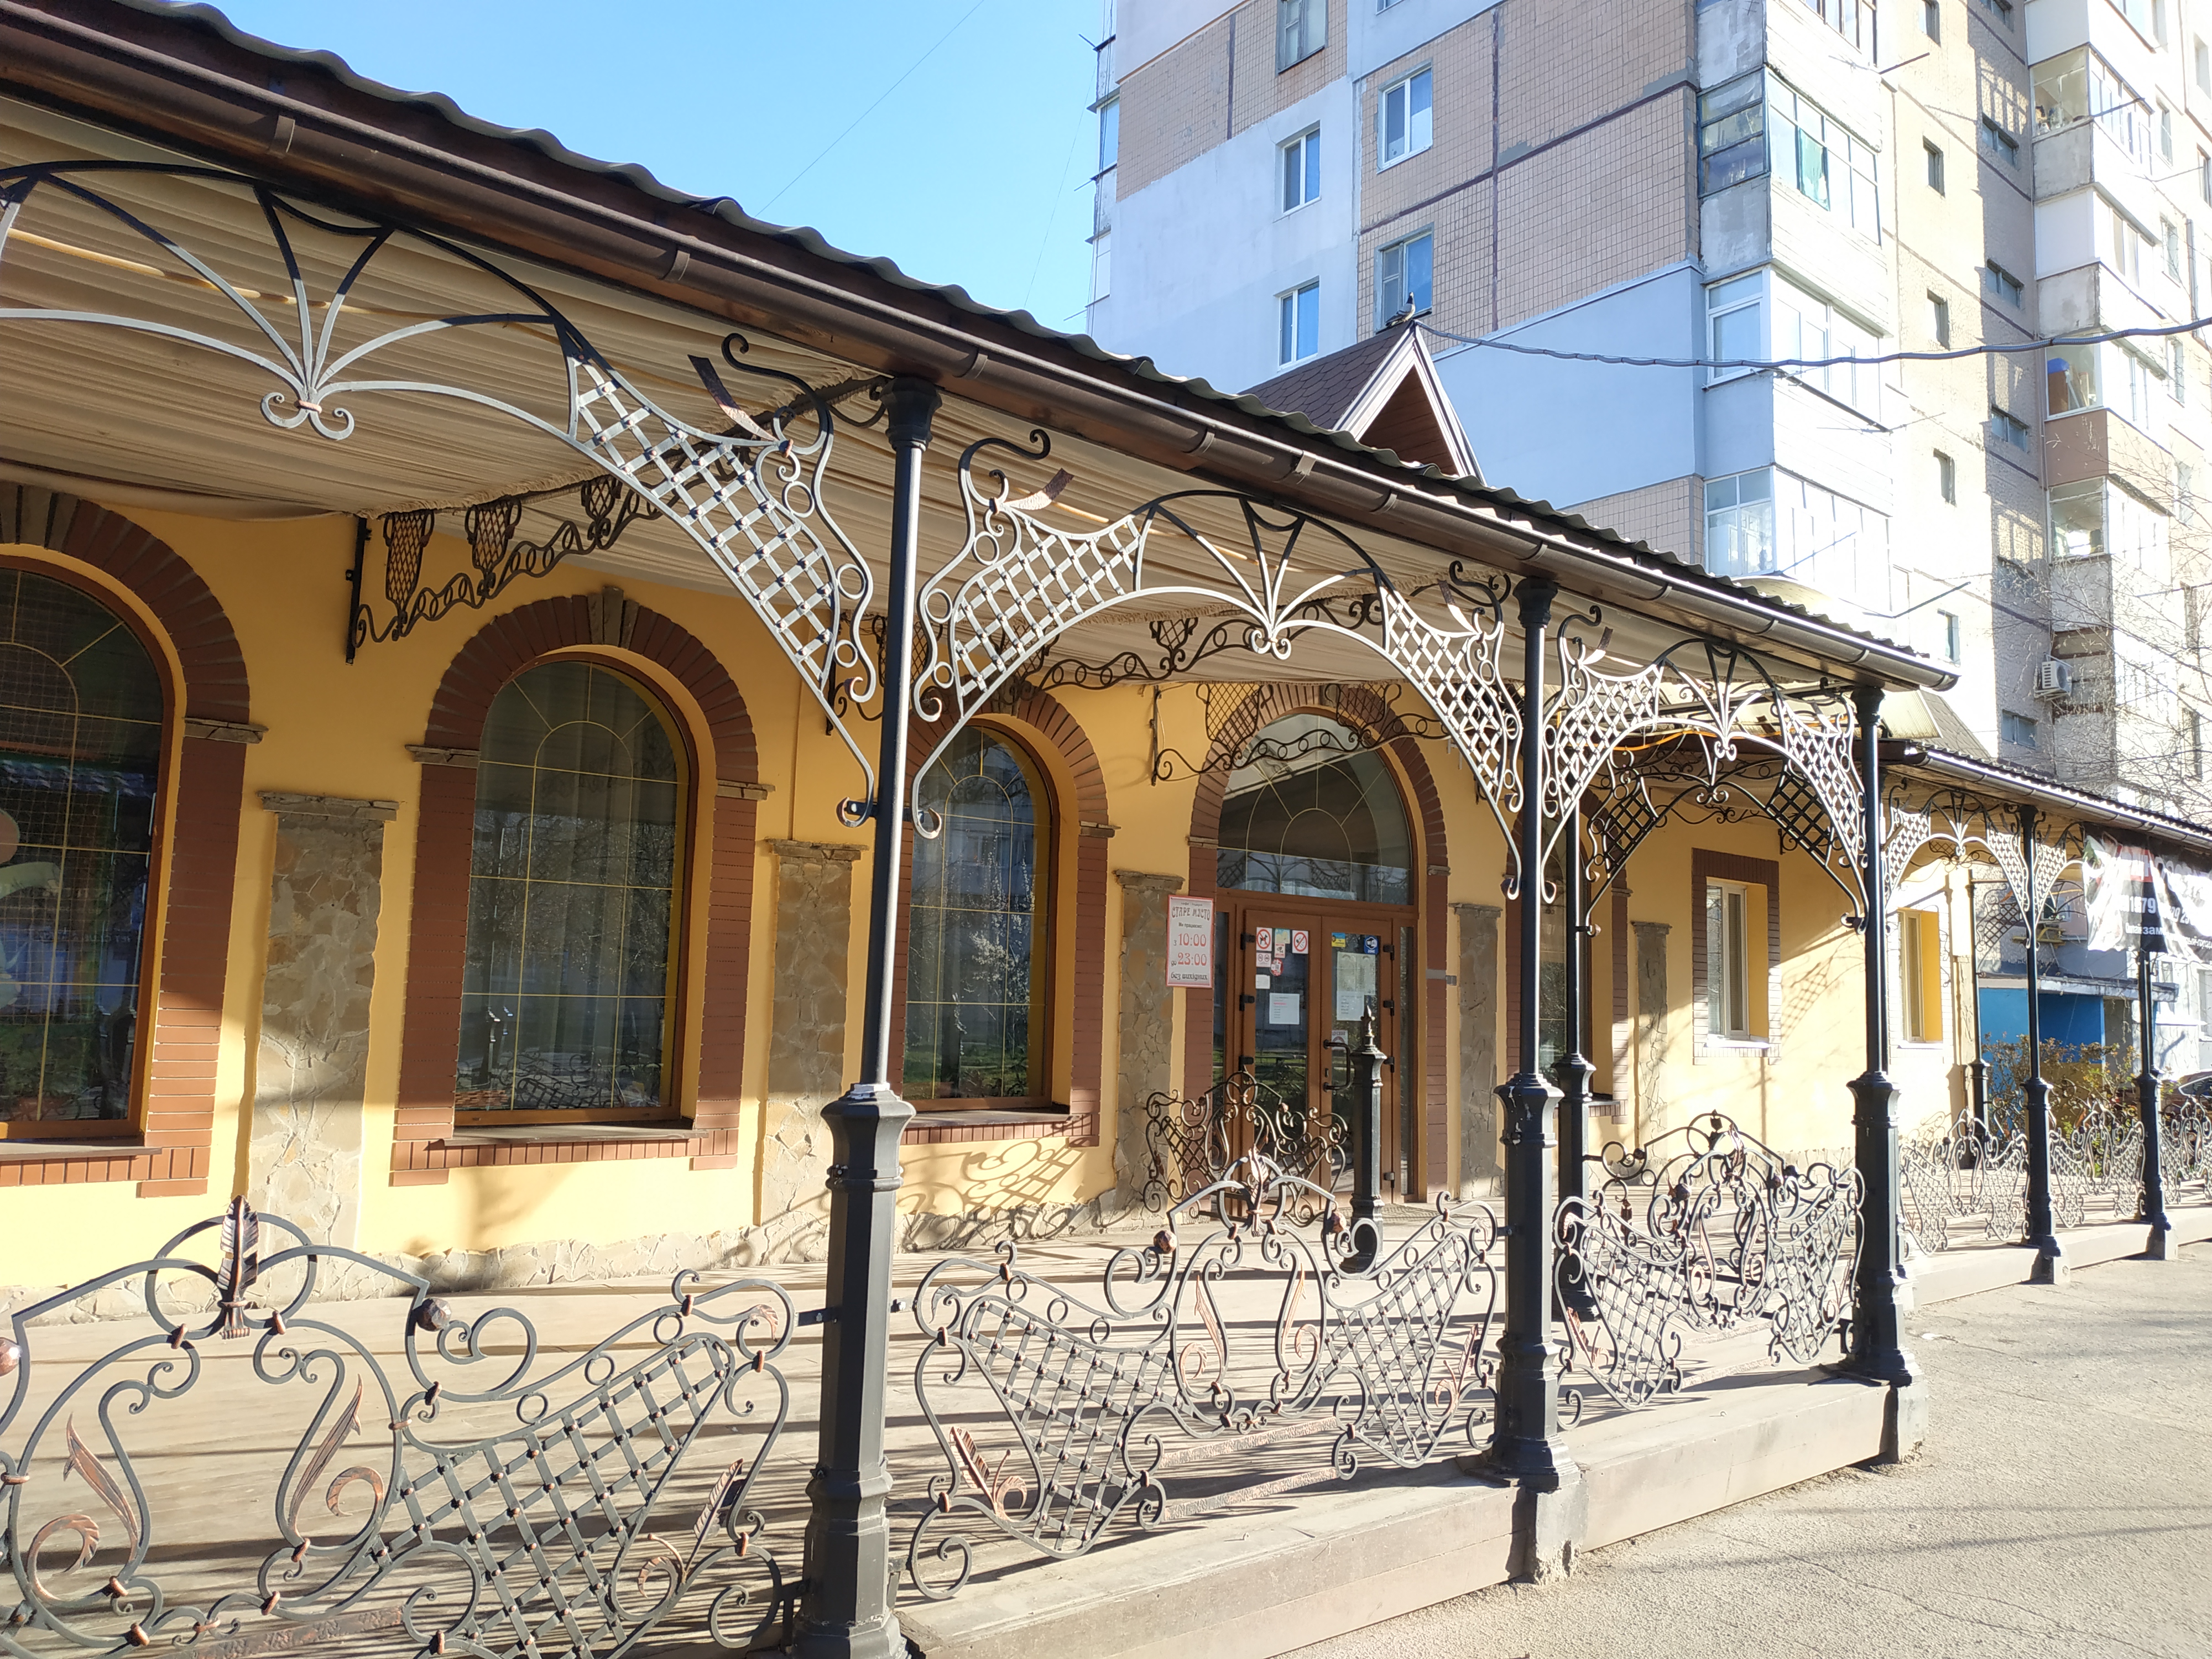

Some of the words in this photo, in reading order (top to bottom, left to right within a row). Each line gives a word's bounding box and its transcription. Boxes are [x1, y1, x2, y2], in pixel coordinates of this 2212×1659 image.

[1172, 906, 1191, 918] СТАРЕ
[1192, 908, 1210, 921] МІСТО
[1178, 933, 1207, 947] 10:00
[1177, 952, 1207, 966] 23:00
[1171, 972, 1181, 980] без
[1182, 973, 1208, 981] вихідних
